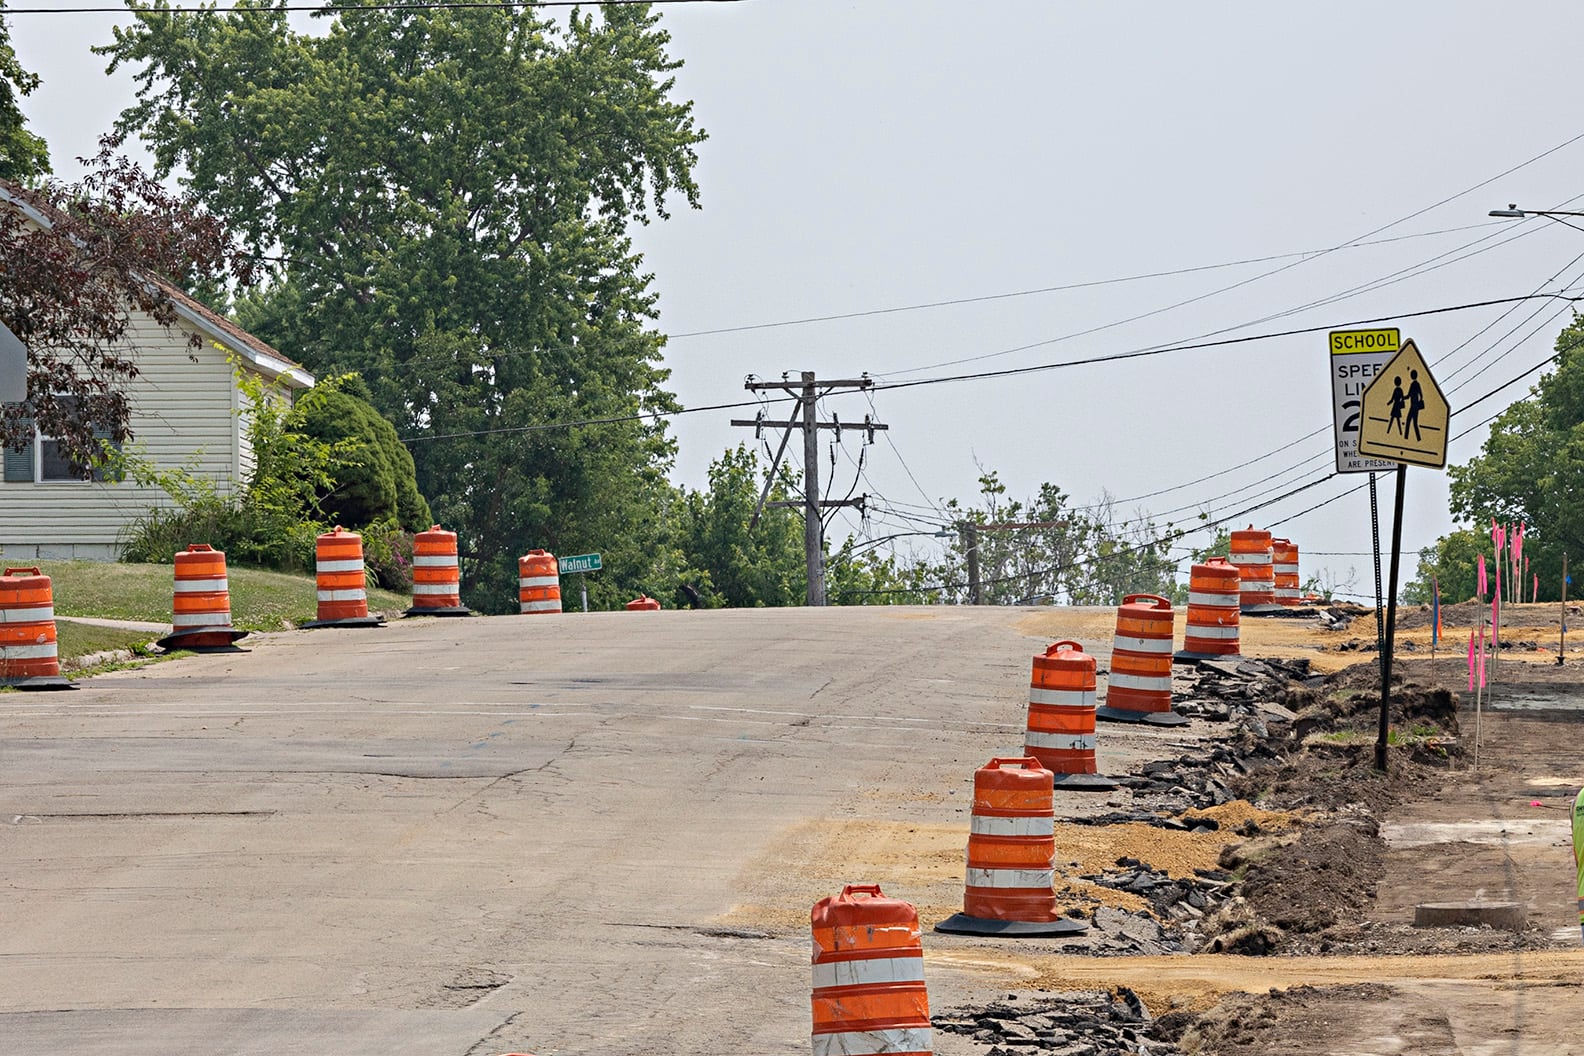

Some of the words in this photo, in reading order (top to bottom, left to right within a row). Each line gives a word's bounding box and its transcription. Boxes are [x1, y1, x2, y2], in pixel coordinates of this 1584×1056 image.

[1334, 334, 1396, 349] SCHOOL
[1338, 364, 1386, 378] SPEE
[1345, 382, 1366, 396] LI
[1342, 400, 1360, 432] 2
[1343, 450, 1357, 458] WHE
[560, 557, 592, 571] Walnut
